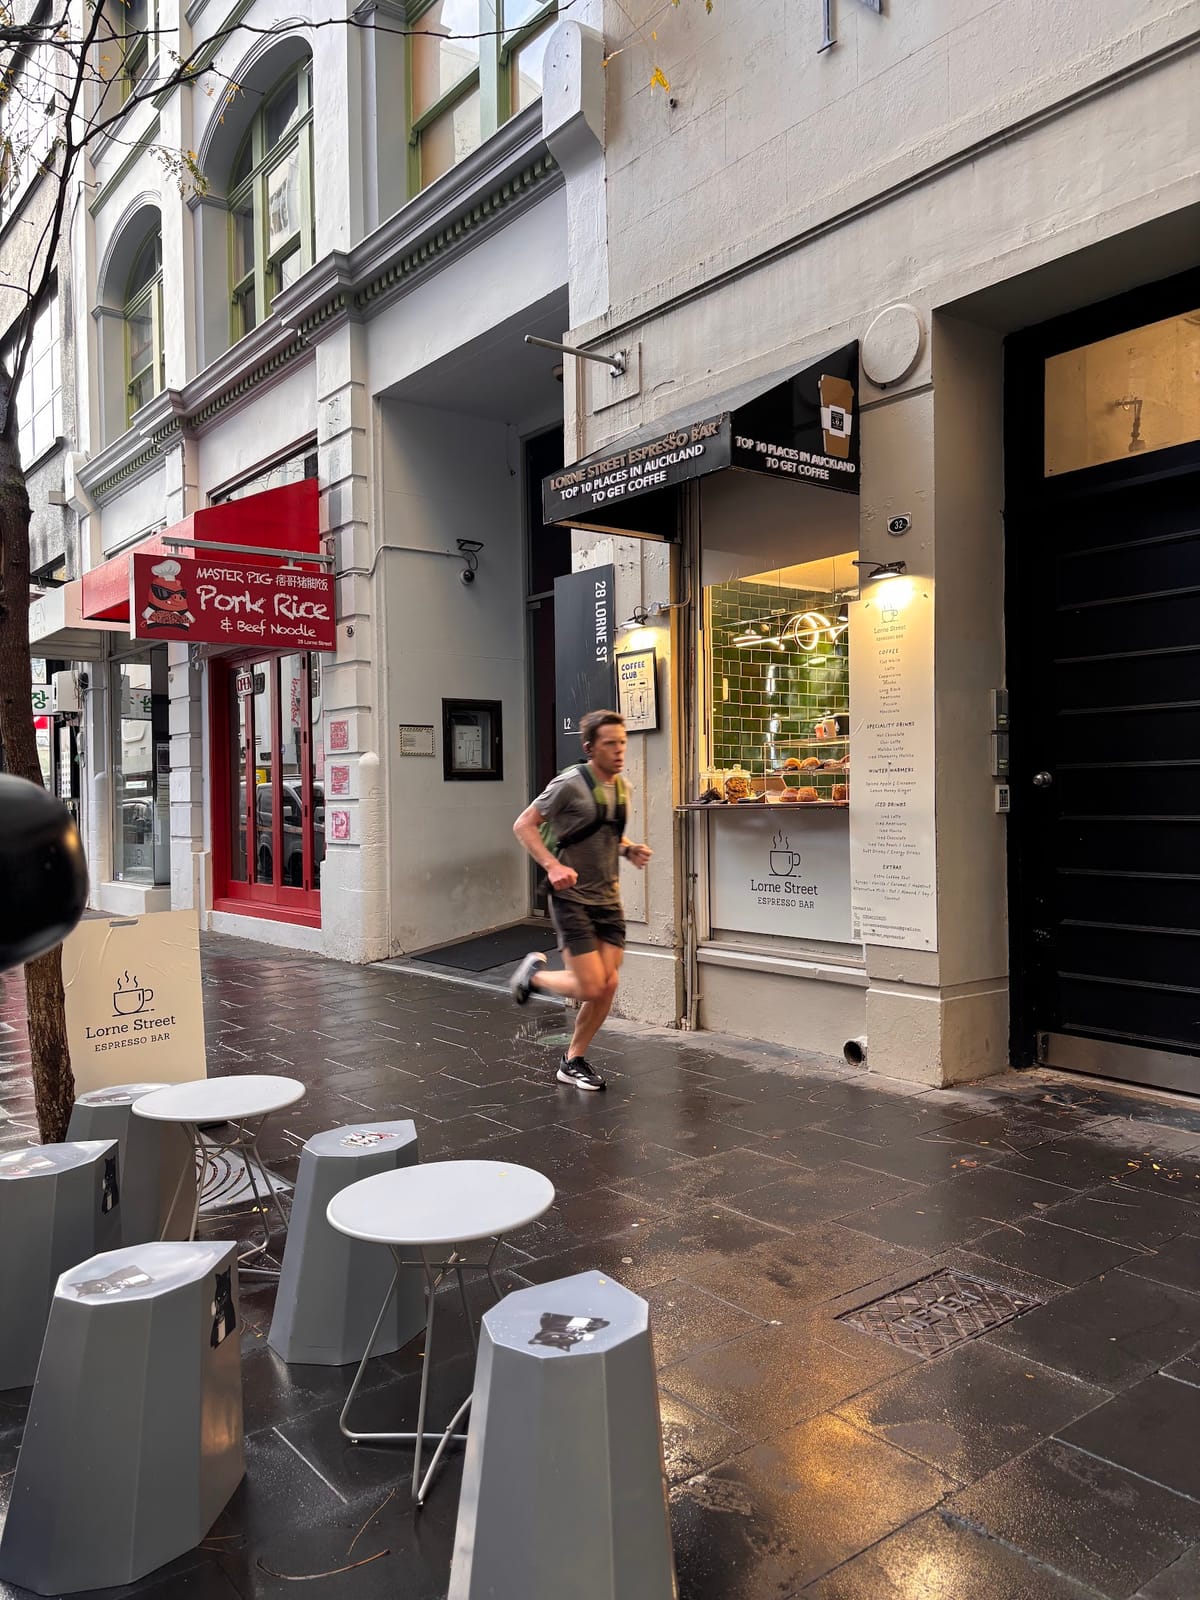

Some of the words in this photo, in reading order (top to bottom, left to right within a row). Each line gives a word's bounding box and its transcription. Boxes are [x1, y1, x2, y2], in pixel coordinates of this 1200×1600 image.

[551, 470, 586, 490] LORNE
[587, 455, 626, 478] STREET
[628, 432, 688, 464] ESPRESSO
[692, 422, 718, 442] BAR
[735, 436, 754, 449] TOP
[756, 441, 767, 453] 10
[768, 444, 798, 460] PLACES
[800, 452, 810, 462] IN
[811, 454, 855, 473] AUCKLAND
[560, 488, 578, 500] TOP
[581, 483, 591, 493] 10
[594, 470, 628, 490] PLACES
[630, 465, 642, 477] IN
[644, 444, 704, 472] AUCKLAND
[766, 457, 779, 468] TO
[780, 460, 797, 473] GET
[798, 464, 829, 480] COFFEE
[592, 492, 605, 503] TO
[608, 484, 626, 498] GET
[628, 471, 667, 490] COFFEE
[196, 568, 244, 583] MASTER
[247, 572, 273, 584] PIG
[595, 581, 606, 598] 28
[196, 585, 266, 614] Pork
[274, 593, 330, 620] Rice
[220, 616, 233, 632] &
[237, 619, 267, 636] Beef
[271, 623, 316, 637] Noodle
[596, 602, 607, 645] LORNE
[596, 647, 608, 663] ST
[621, 660, 645, 672] COFFEE
[622, 670, 638, 681] CLUB
[564, 717, 571, 730] L2
[750, 880, 780, 893] Lorne
[784, 882, 818, 896] Street
[757, 897, 796, 907] ESPRESSO
[799, 900, 814, 909] BAR
[85, 1024, 129, 1039] Lorne
[133, 1015, 176, 1031] Street
[95, 1036, 147, 1052] ESPRESSO
[151, 1033, 170, 1043] BAR
